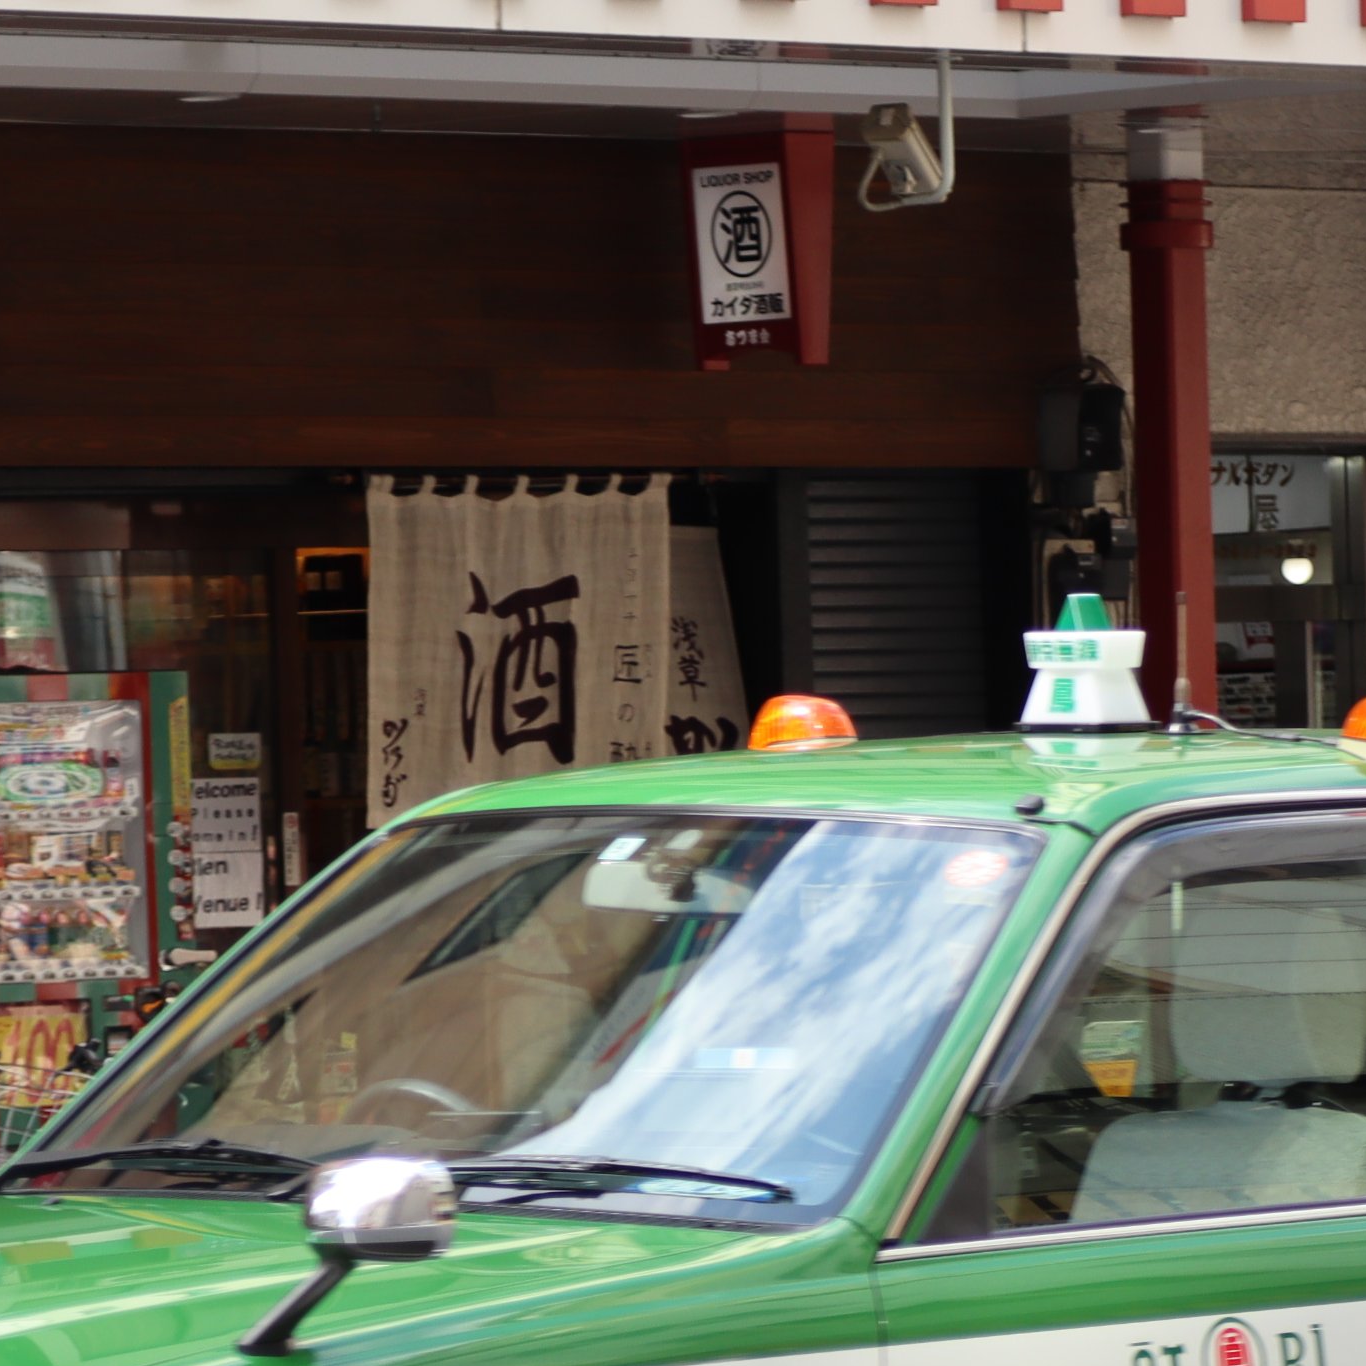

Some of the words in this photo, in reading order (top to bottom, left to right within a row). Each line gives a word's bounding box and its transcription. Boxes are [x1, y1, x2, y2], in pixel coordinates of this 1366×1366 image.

[701, 174, 741, 188] LIQUOR
[744, 170, 774, 184] SHOP
[720, 206, 762, 264] 酒
[456, 571, 580, 766] 酒
[191, 781, 257, 799] elcome
